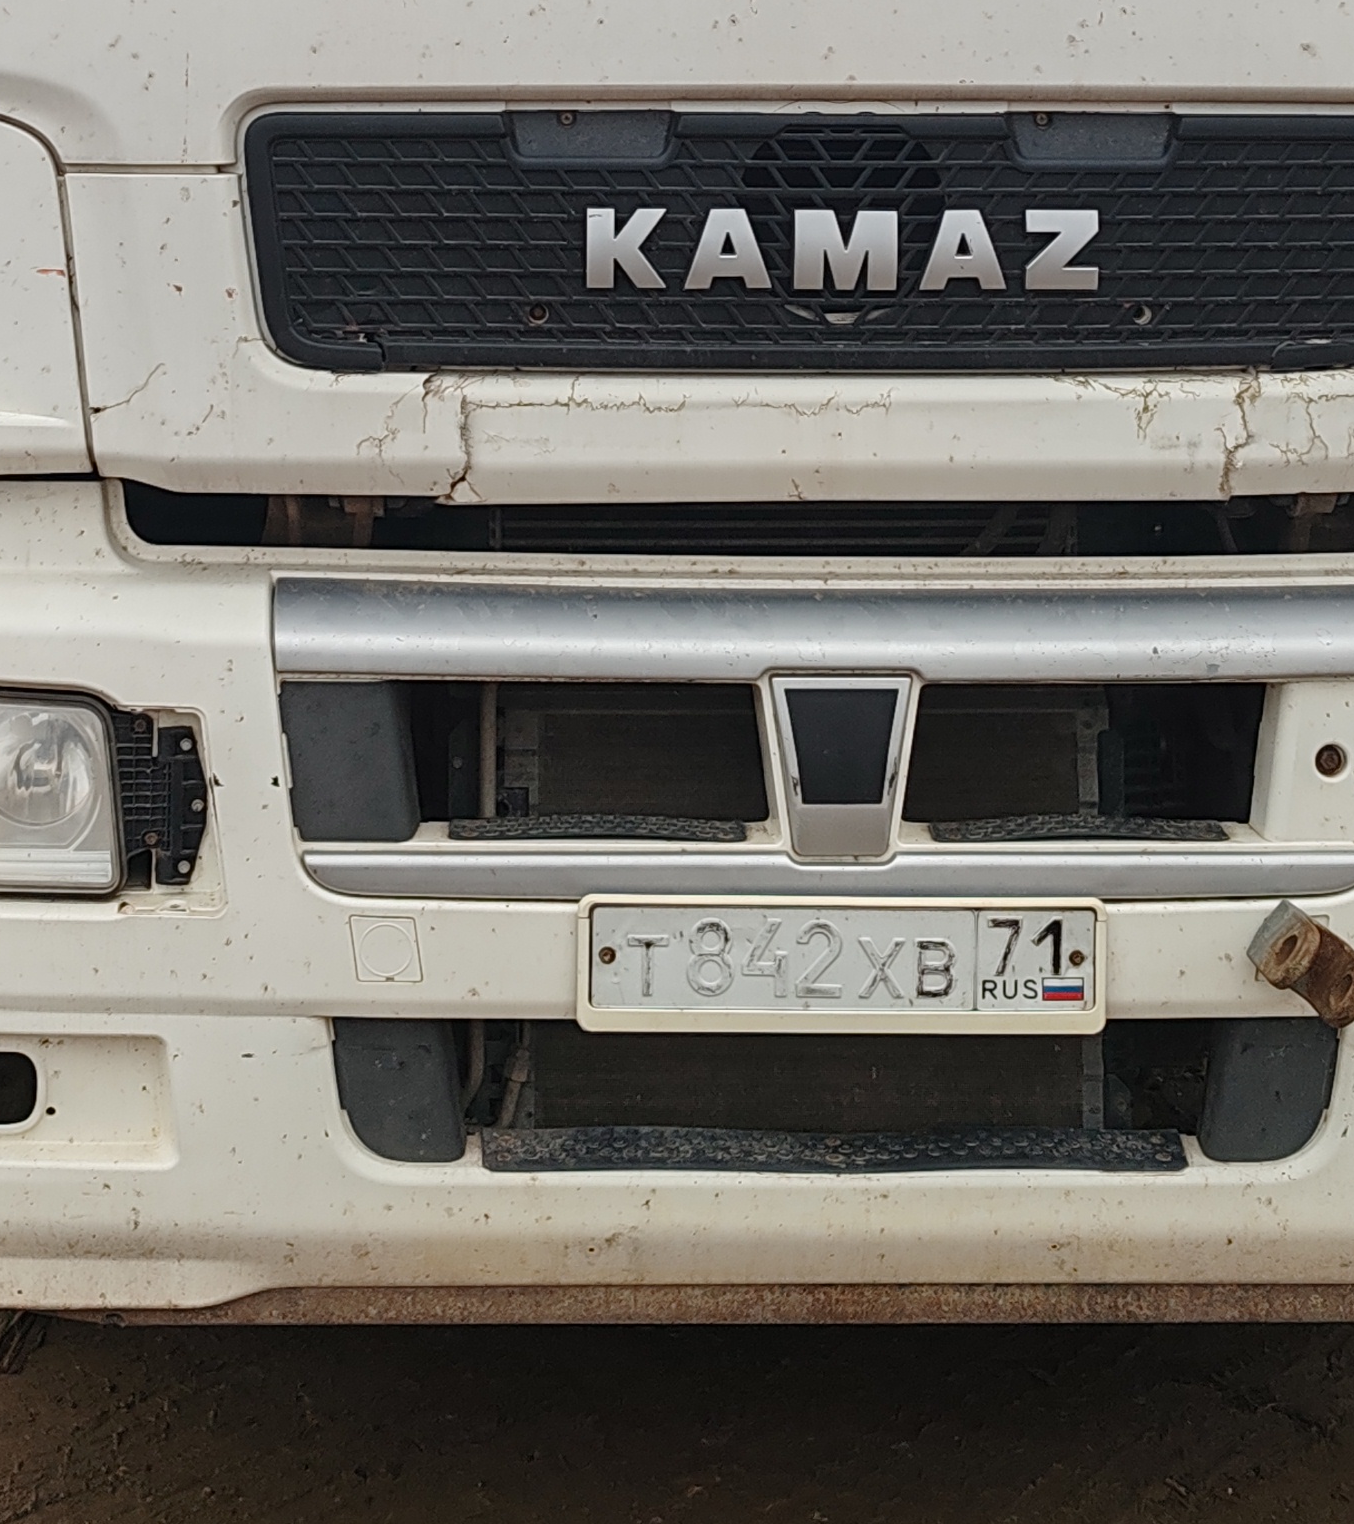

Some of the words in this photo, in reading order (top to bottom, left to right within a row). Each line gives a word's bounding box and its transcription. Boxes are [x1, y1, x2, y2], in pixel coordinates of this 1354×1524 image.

[585, 207, 1100, 291] KAMAZ
[986, 915, 1064, 976] 71
[981, 978, 1039, 1001] RUS
